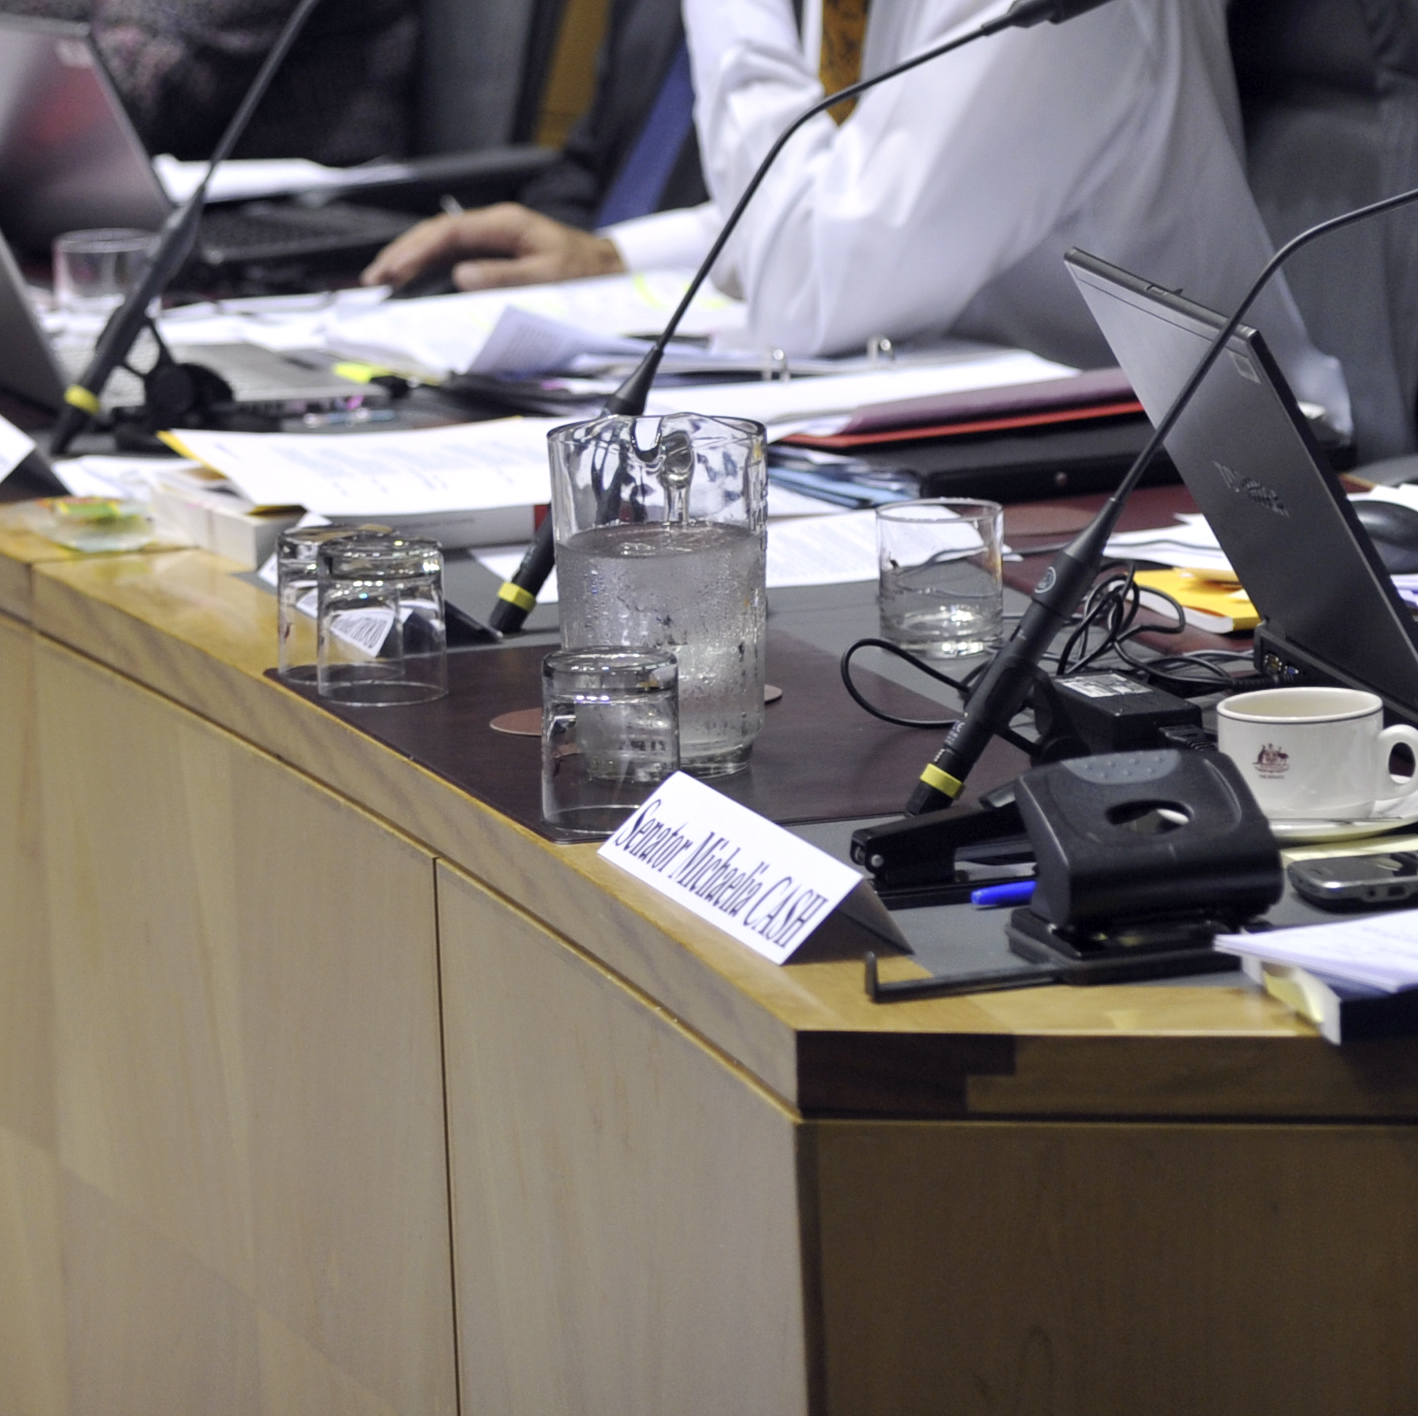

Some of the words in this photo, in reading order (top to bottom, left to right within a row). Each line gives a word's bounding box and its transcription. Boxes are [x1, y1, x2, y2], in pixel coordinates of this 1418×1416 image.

[613, 798, 692, 872] Senator
[668, 831, 769, 918] Michaelia
[742, 876, 830, 949] CASH
